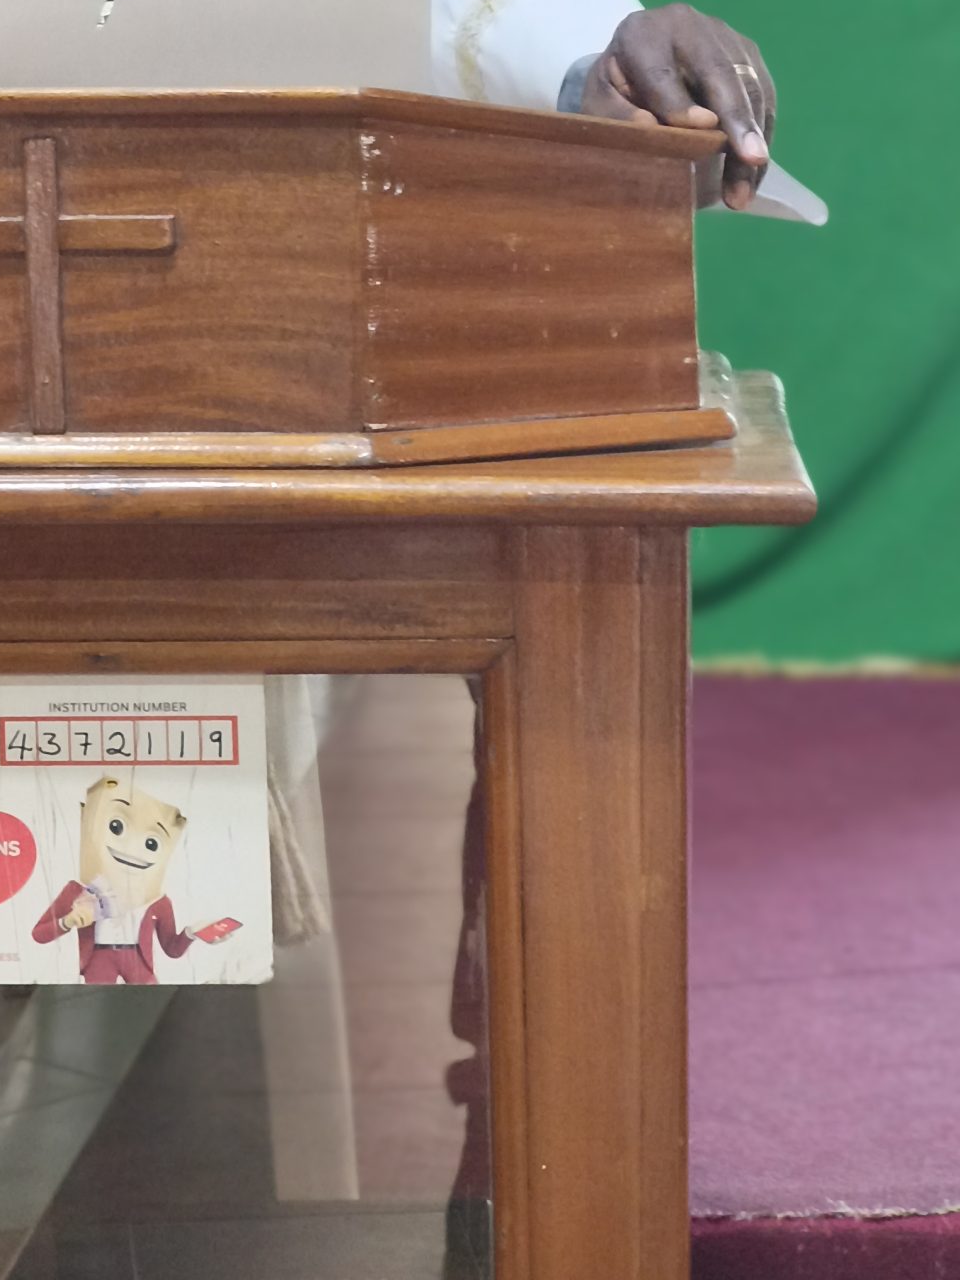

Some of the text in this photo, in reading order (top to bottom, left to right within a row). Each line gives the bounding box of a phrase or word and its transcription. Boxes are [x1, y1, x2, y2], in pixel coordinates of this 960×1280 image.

[48, 702, 188, 712] INSTITUTION NUMBER
[8, 729, 223, 760] 4372119
